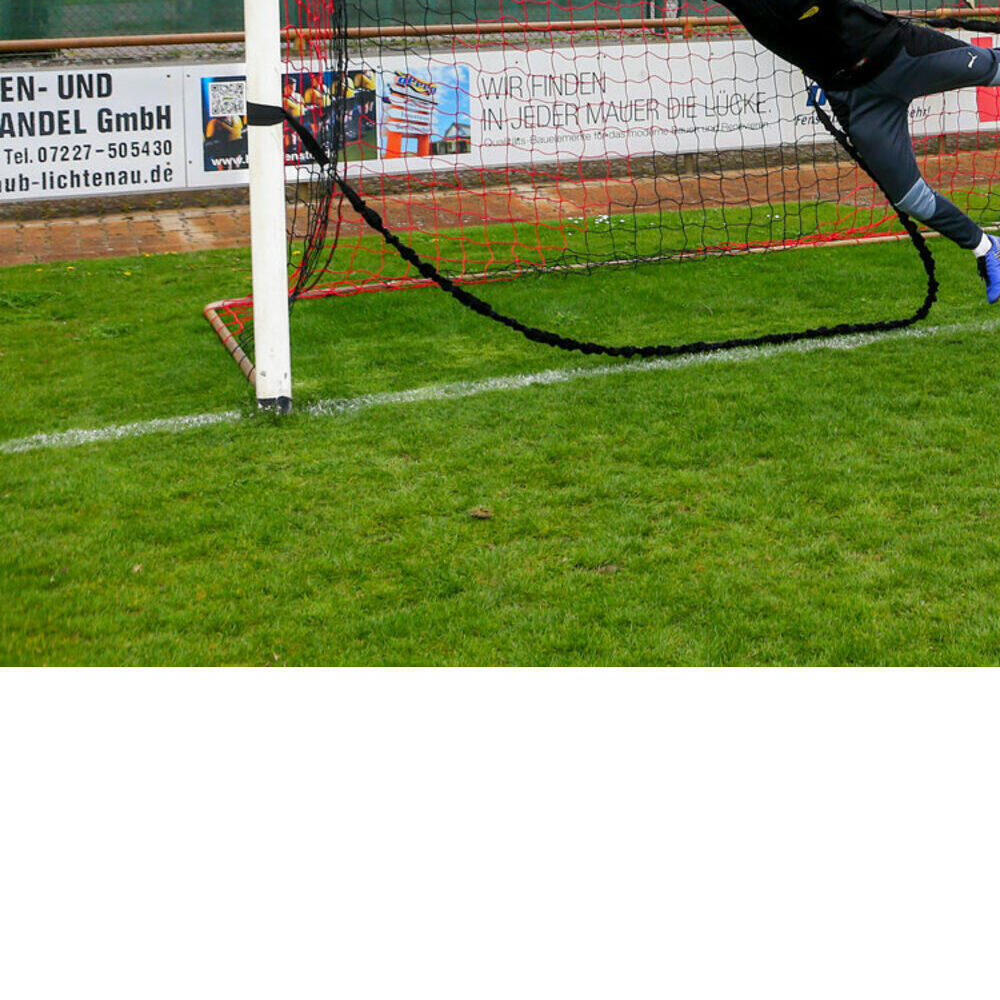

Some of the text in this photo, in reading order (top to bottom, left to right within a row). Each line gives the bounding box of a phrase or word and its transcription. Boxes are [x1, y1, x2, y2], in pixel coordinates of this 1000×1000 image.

[0, 73, 113, 103] EN- UND
[482, 72, 606, 100] WIR FINDEN
[0, 105, 172, 139] ANDEL GmbH
[483, 107, 502, 131] IN
[511, 103, 579, 130] JEDER
[587, 98, 660, 124] MAUER
[667, 96, 697, 120] DIE
[4, 146, 33, 165] Tel.
[0, 164, 173, 194] ub-lichtenau.de
